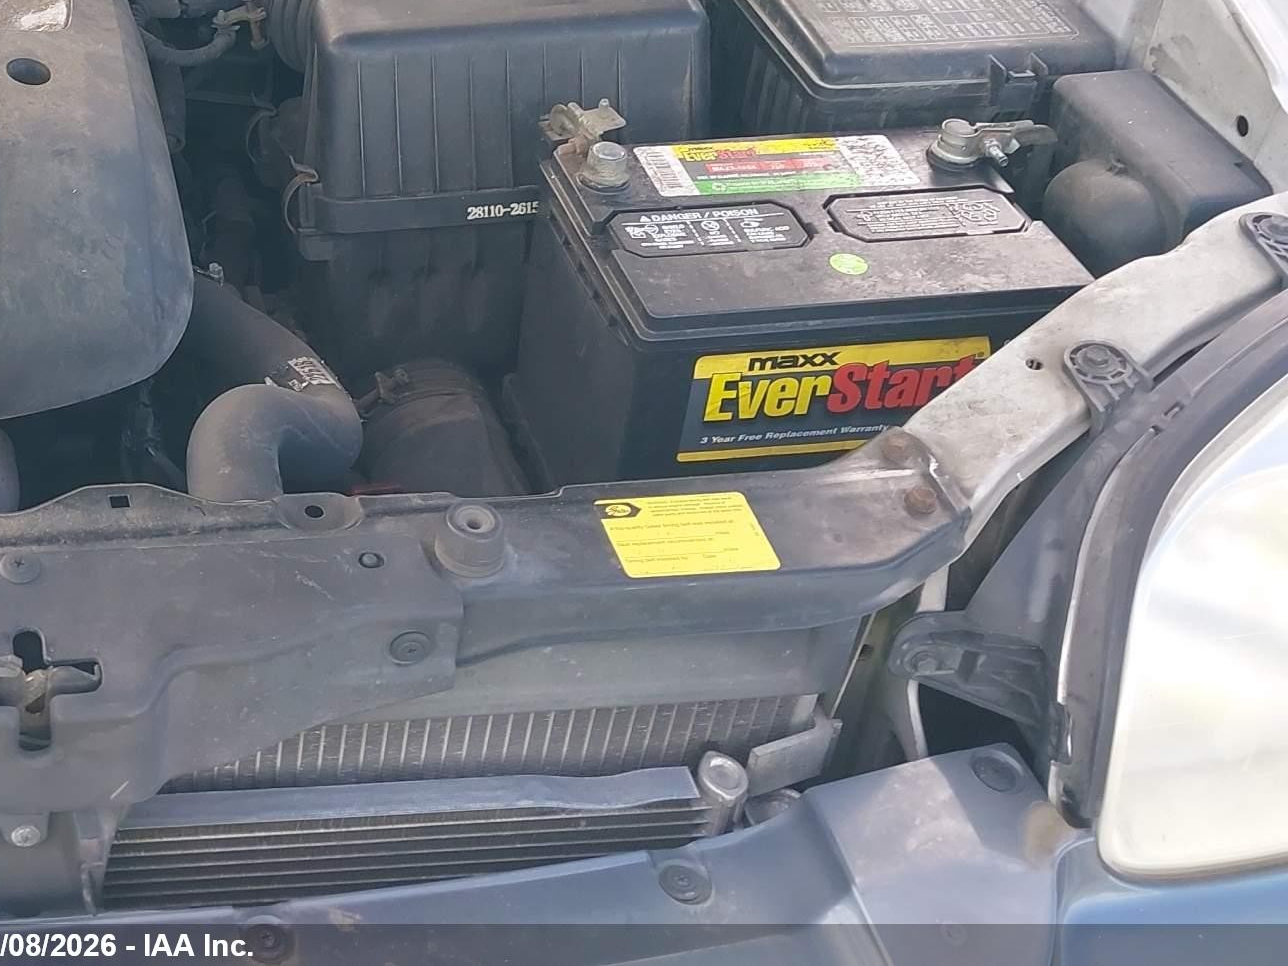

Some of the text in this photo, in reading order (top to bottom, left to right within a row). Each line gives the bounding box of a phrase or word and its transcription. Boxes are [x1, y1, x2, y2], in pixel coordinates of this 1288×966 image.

[651, 211, 702, 221] DANGER
[712, 208, 760, 217] POISON
[748, 351, 843, 372] maxx
[711, 435, 736, 444] Year
[737, 433, 762, 442] Free
[765, 427, 838, 441] Replacement
[841, 424, 889, 434] Warranty
